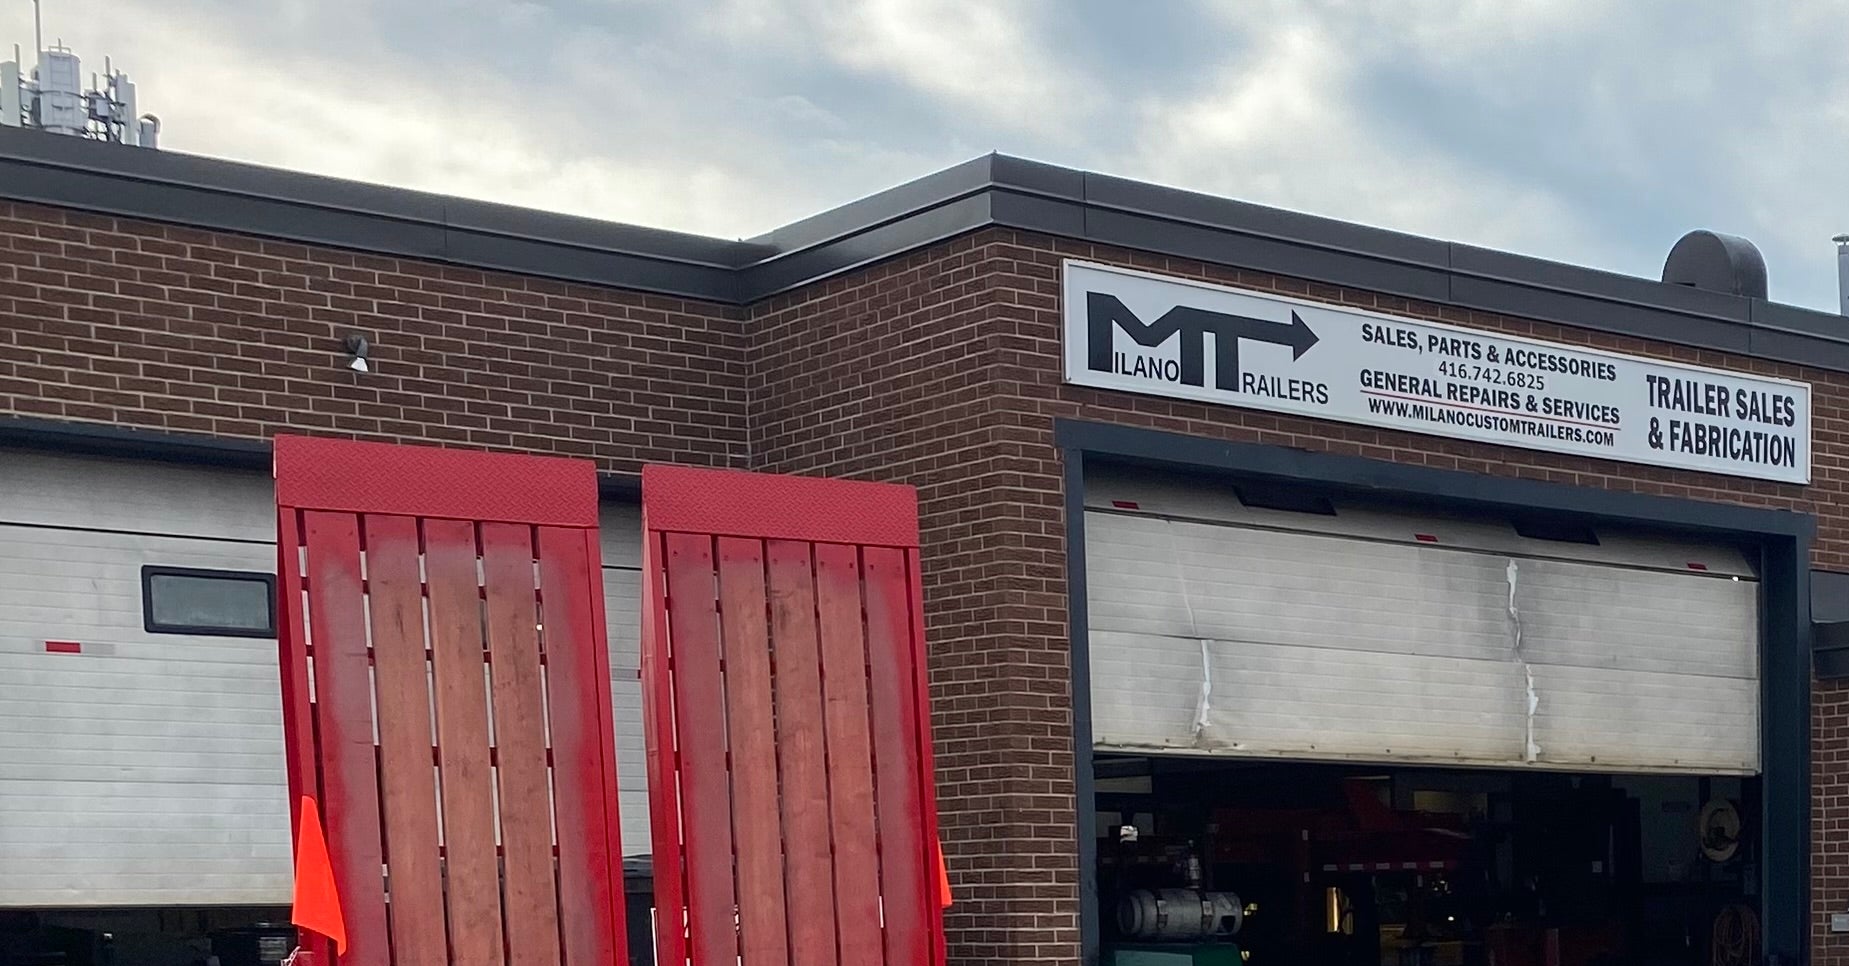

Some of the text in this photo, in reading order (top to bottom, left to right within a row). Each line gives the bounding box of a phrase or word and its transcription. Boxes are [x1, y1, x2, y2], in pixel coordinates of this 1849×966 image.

[1362, 323, 1616, 381] SALES, PARTS & ACCESSORIES
[1438, 361, 1545, 390] 416.742.6825
[1360, 369, 1620, 424] GENERAL REPAIRS & SERVICES
[1368, 398, 1614, 447] WWW.MILANOCUSTOMTRAILERS.COM
[1646, 374, 1795, 427] TRAILER SALES
[1648, 416, 1795, 468] & FABRICATION
